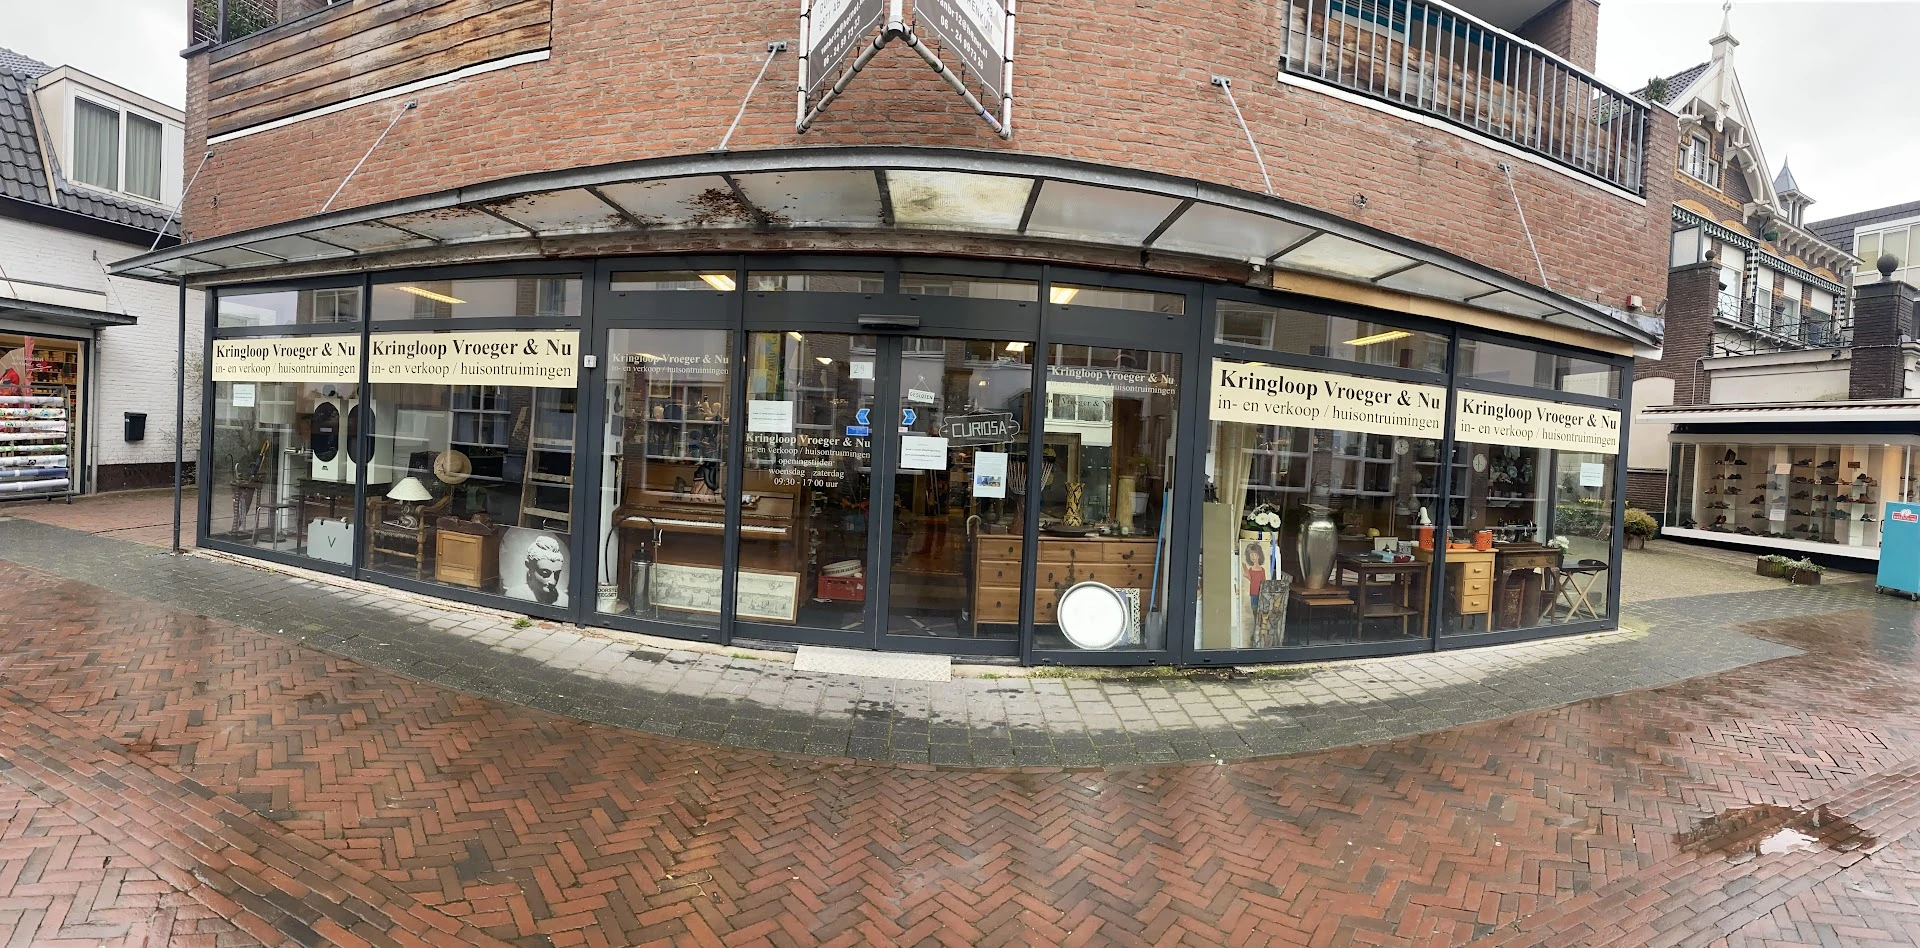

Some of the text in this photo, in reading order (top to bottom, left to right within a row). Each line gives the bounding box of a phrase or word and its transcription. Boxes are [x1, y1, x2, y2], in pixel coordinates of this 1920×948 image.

[940, 15, 949, 30] 06
[955, 29, 963, 44] 24
[216, 341, 356, 362] Kringloop Vroeger & Nu
[372, 338, 572, 360] Kringloop Vroeger & Nu
[612, 353, 729, 365] Kringloop Vroeger & Nu
[215, 362, 356, 377] in- en verkoop / huisontruimingen
[371, 362, 572, 380] in- en verkoop / huisontruimingen
[633, 365, 660, 374] verkoop
[667, 366, 729, 376] huisontruimingen
[853, 364, 865, 374] 29
[1051, 366, 1174, 385] Kringloop Vroeger & Nu
[909, 391, 934, 400] GESLOTEN
[1110, 383, 1176, 396] huisontruimingen
[1220, 369, 1440, 410] Kringloop Vroeger & Nu
[1218, 394, 1439, 430] in- en verkoop / huisontruimingen
[1462, 398, 1617, 430] Kringloop Vroeger & Nu
[951, 420, 1008, 439] CURIOSA
[1460, 421, 1617, 448] in- en verkoop / huisontruimingen
[746, 433, 871, 448] Kringloop Vroeger & Nu
[745, 445, 755, 453] in-
[768, 446, 798, 456] verkoop
[805, 447, 871, 459] huisontruimingen
[768, 468, 845, 479] woensdag zaterdag
[774, 477, 795, 486] 09:30
